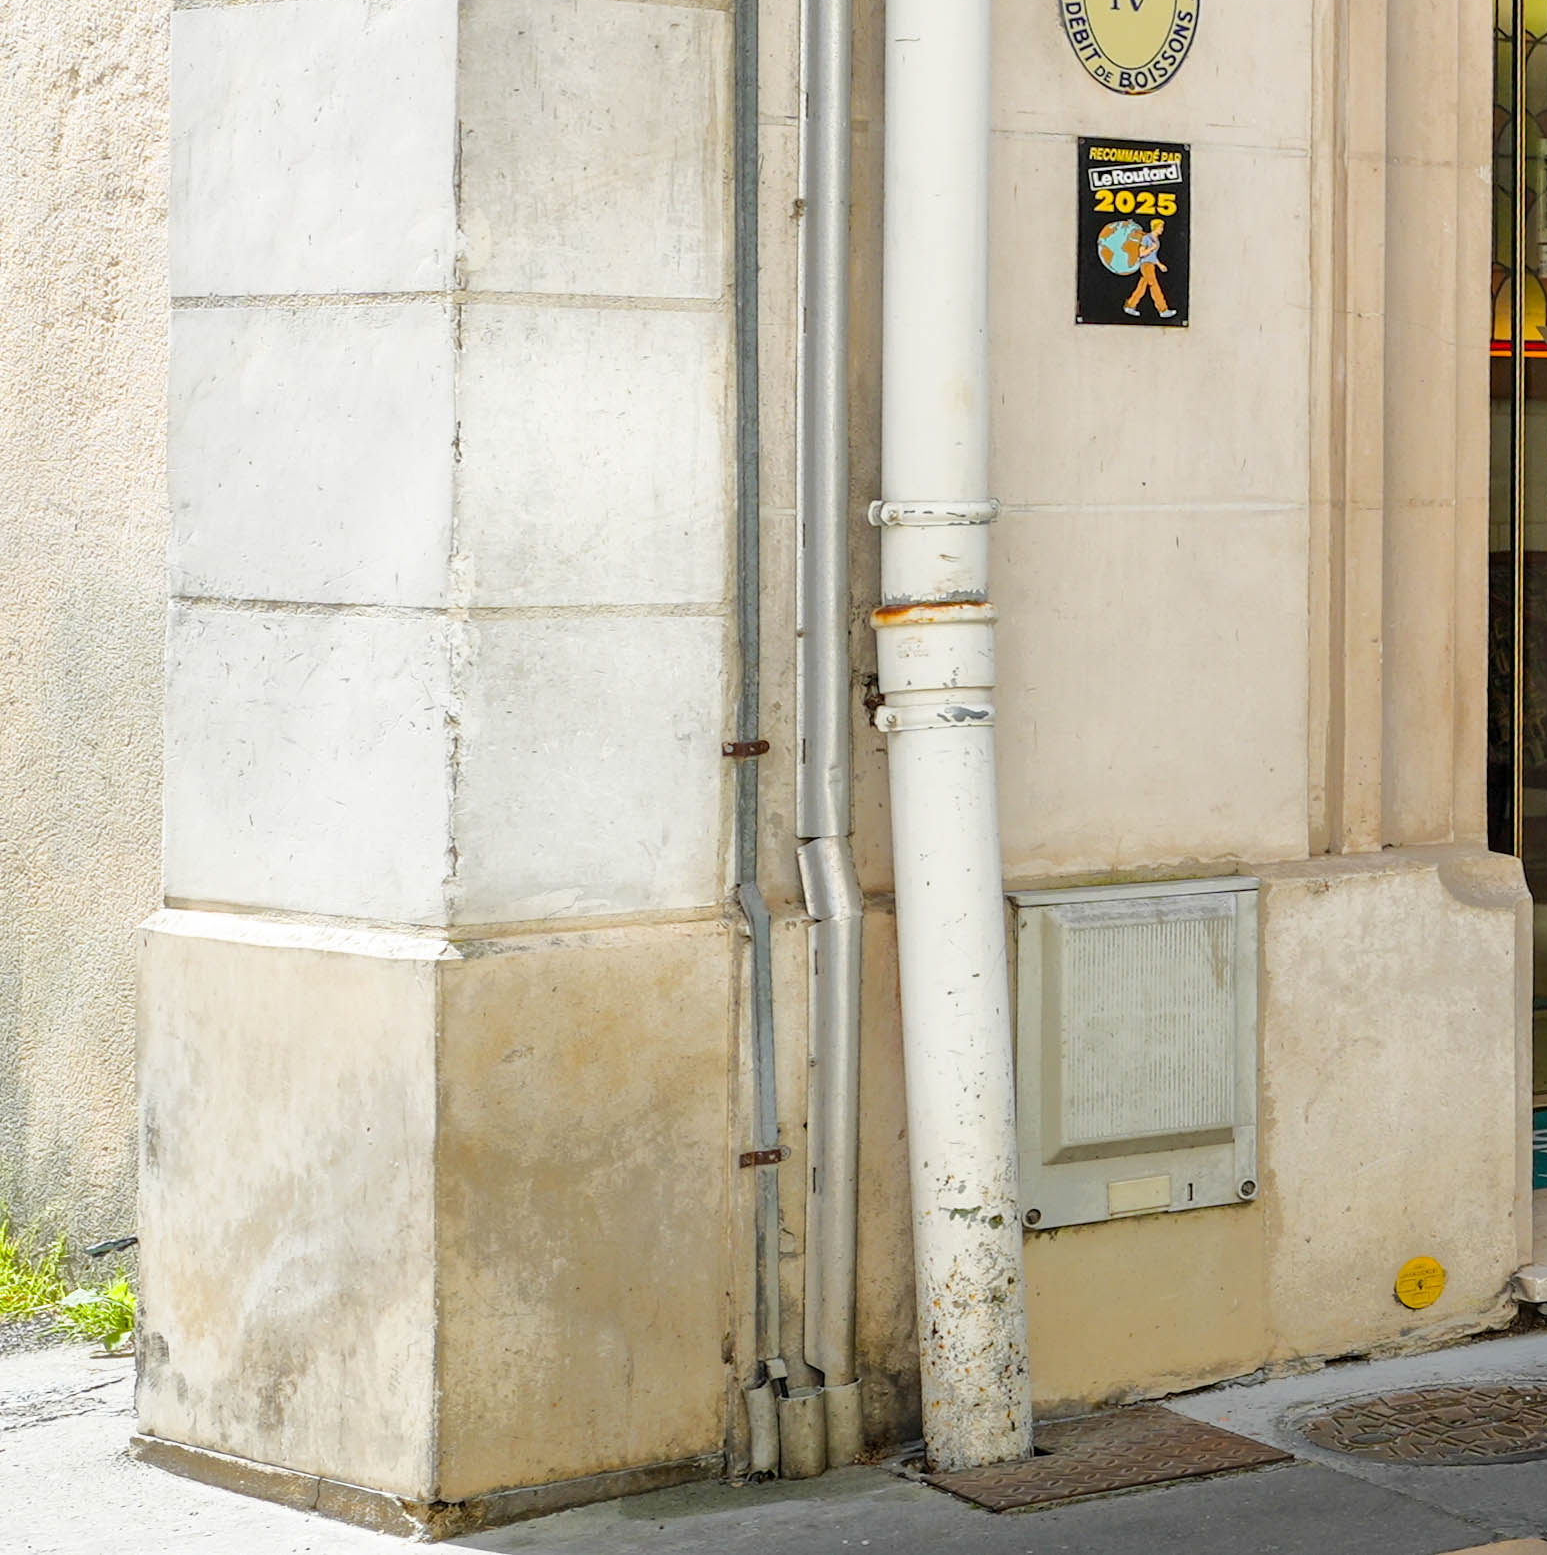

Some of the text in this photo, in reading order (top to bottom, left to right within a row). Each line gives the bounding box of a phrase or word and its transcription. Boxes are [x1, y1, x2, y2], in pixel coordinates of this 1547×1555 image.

[1094, 65, 1114, 83] DE
[1119, 11, 1193, 88] BOISSONS
[1089, 147, 1182, 163] RECOMMANDÉ PAR
[1094, 189, 1177, 216] 2025
